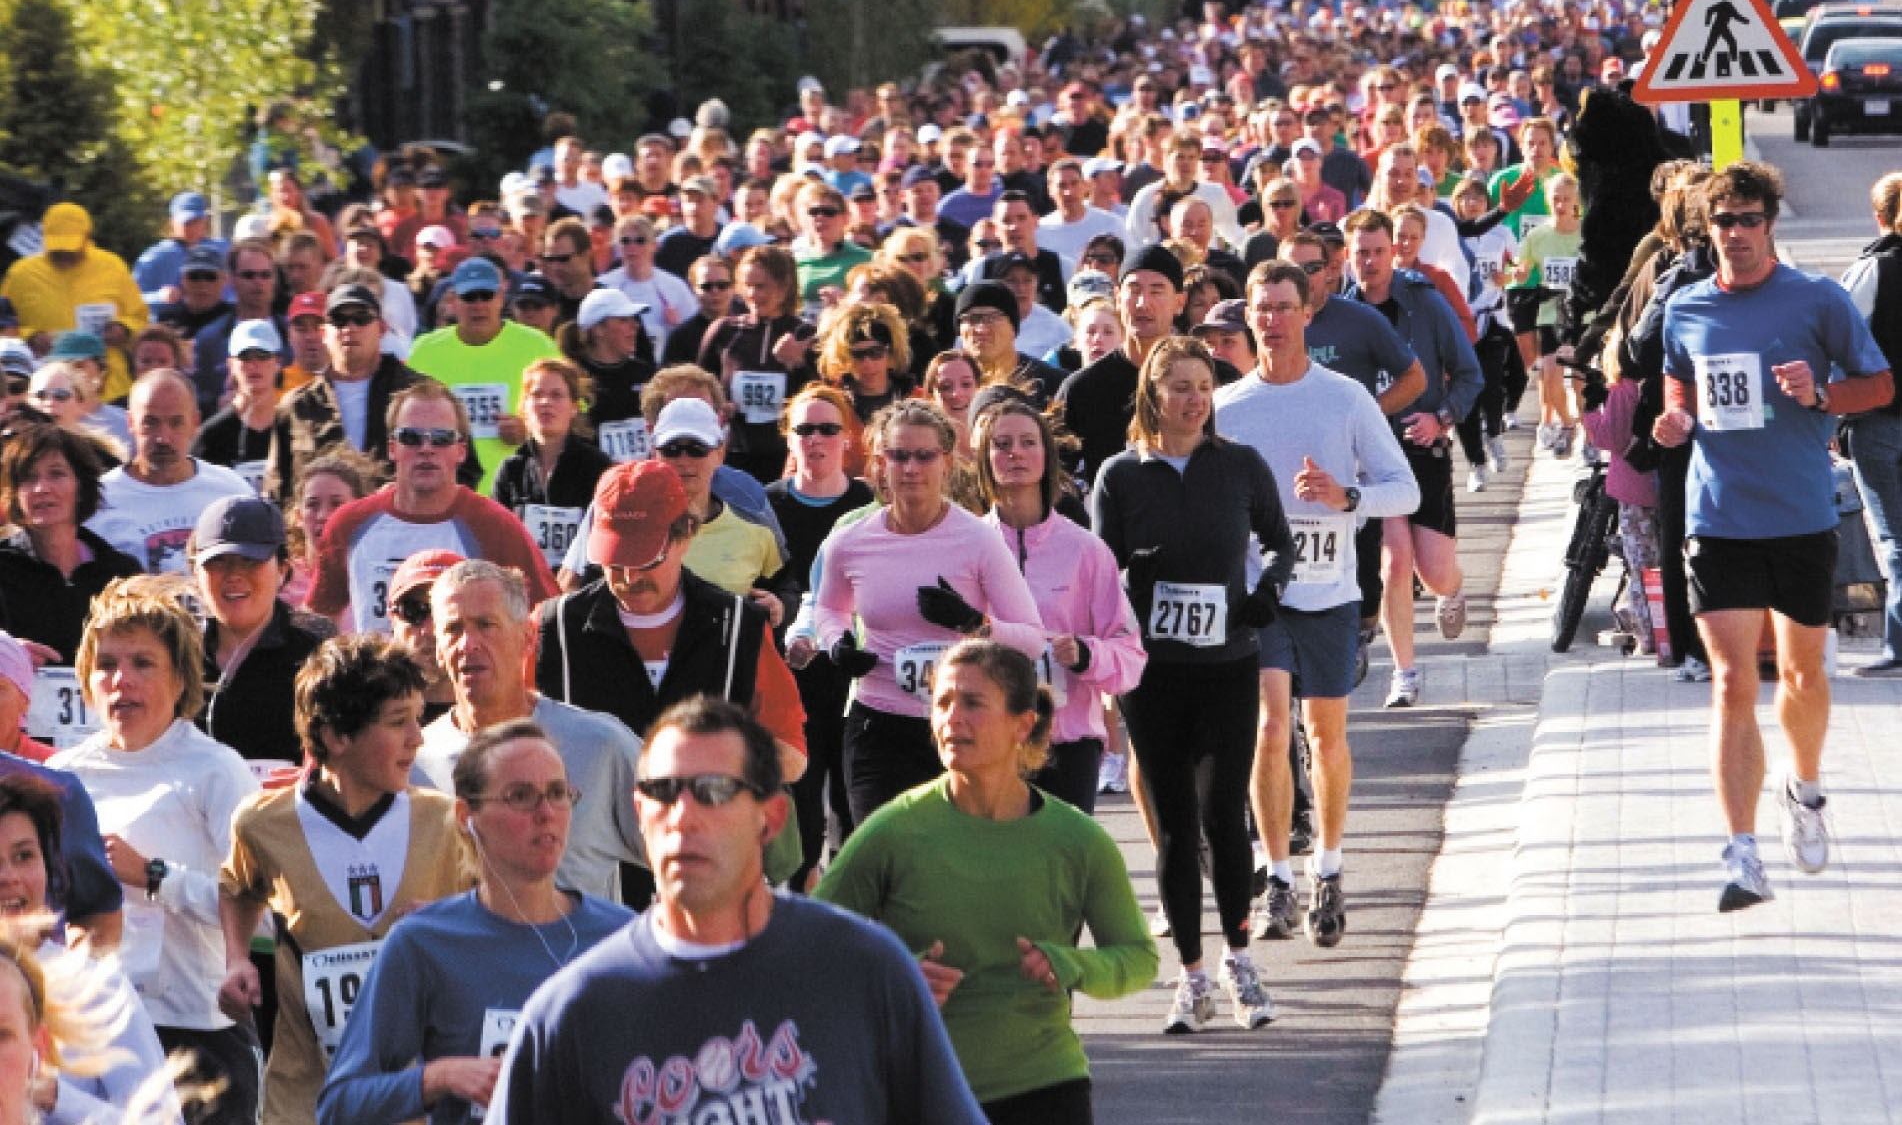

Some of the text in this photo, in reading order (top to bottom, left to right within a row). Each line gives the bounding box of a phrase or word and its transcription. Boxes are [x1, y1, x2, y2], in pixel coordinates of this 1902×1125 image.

[743, 383, 775, 406] 992
[1294, 531, 1337, 562] 214
[1156, 601, 1216, 636] 2767
